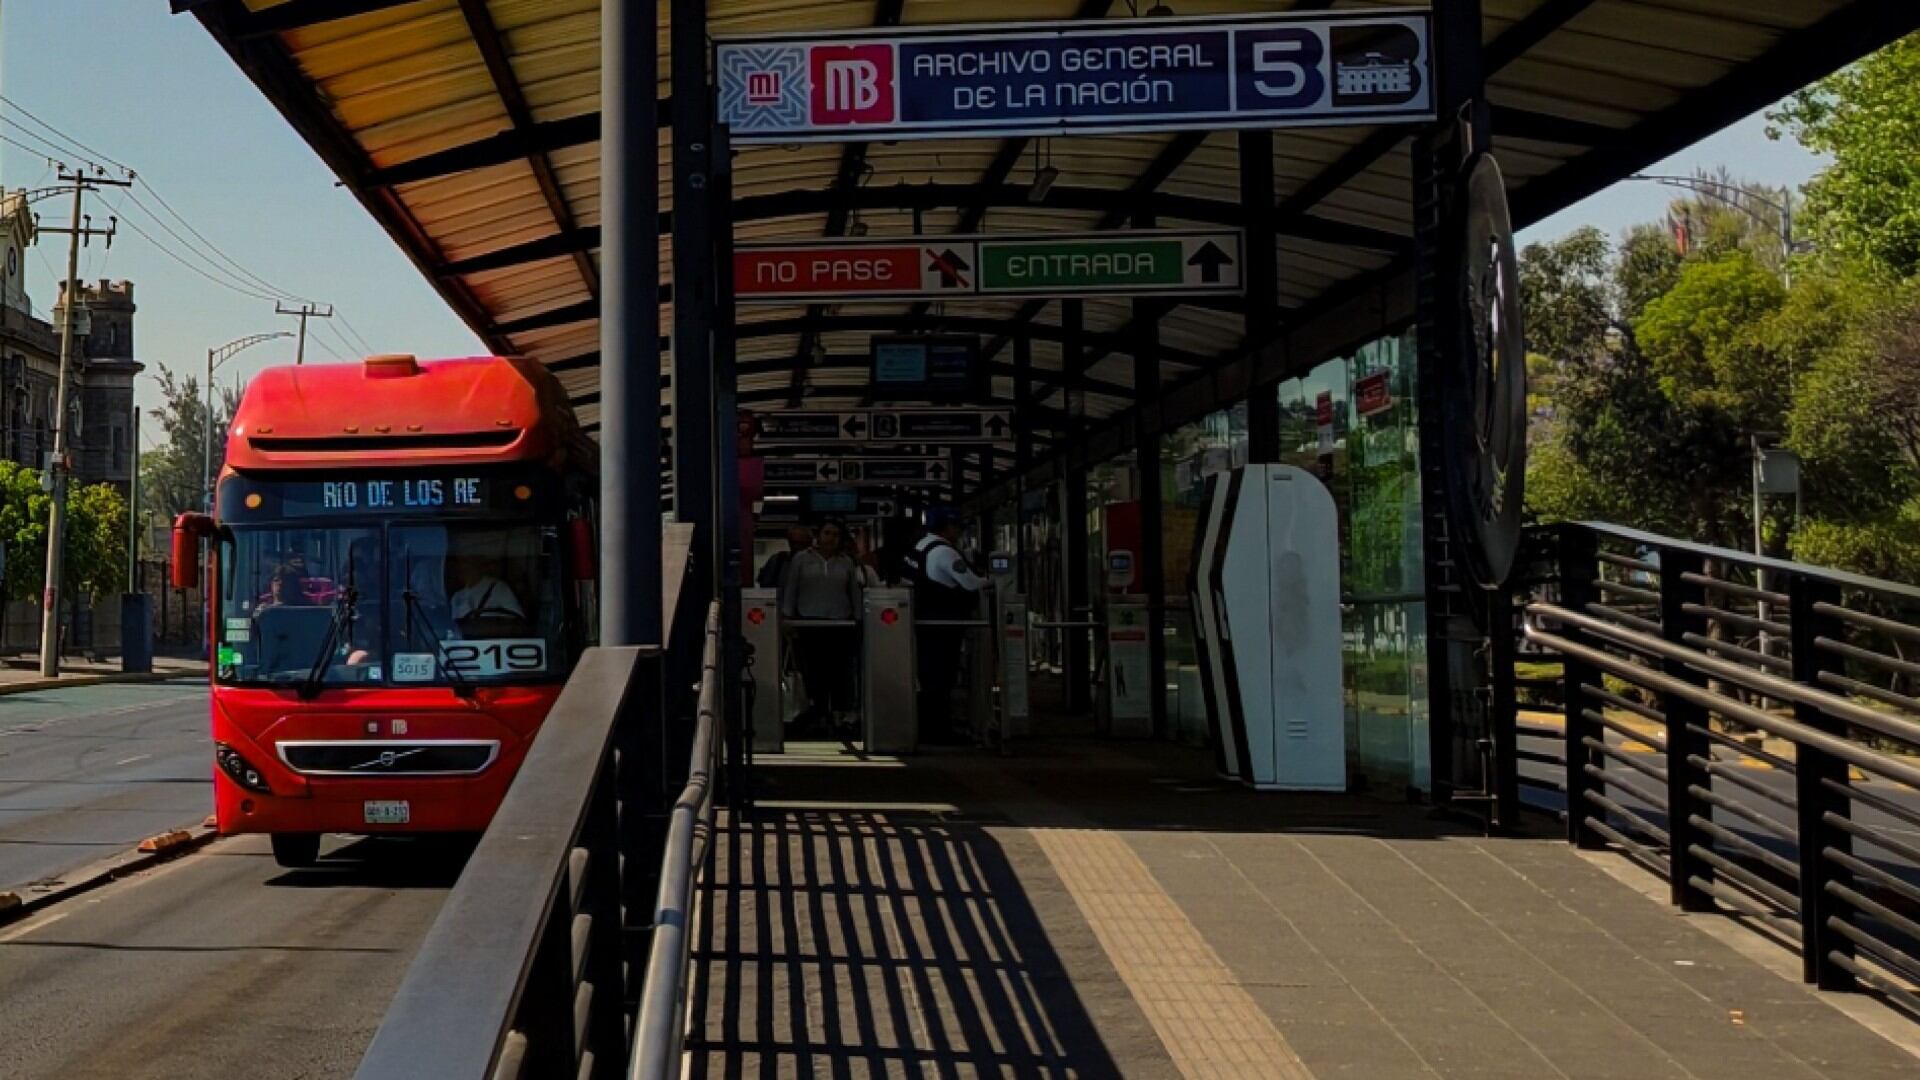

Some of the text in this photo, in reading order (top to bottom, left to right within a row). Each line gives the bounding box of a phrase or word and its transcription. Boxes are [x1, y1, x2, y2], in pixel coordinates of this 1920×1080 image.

[913, 43, 1215, 77] ARCHIVO GENERAL
[1252, 40, 1307, 98] 5
[953, 73, 1175, 110] DE LA NACIÓN
[756, 259, 894, 284] NO PASE
[1006, 252, 1156, 278] ENTRADA
[367, 480, 395, 507] DE
[404, 479, 444, 506] LOS
[454, 477, 482, 504] RE
[446, 644, 543, 670] 219
